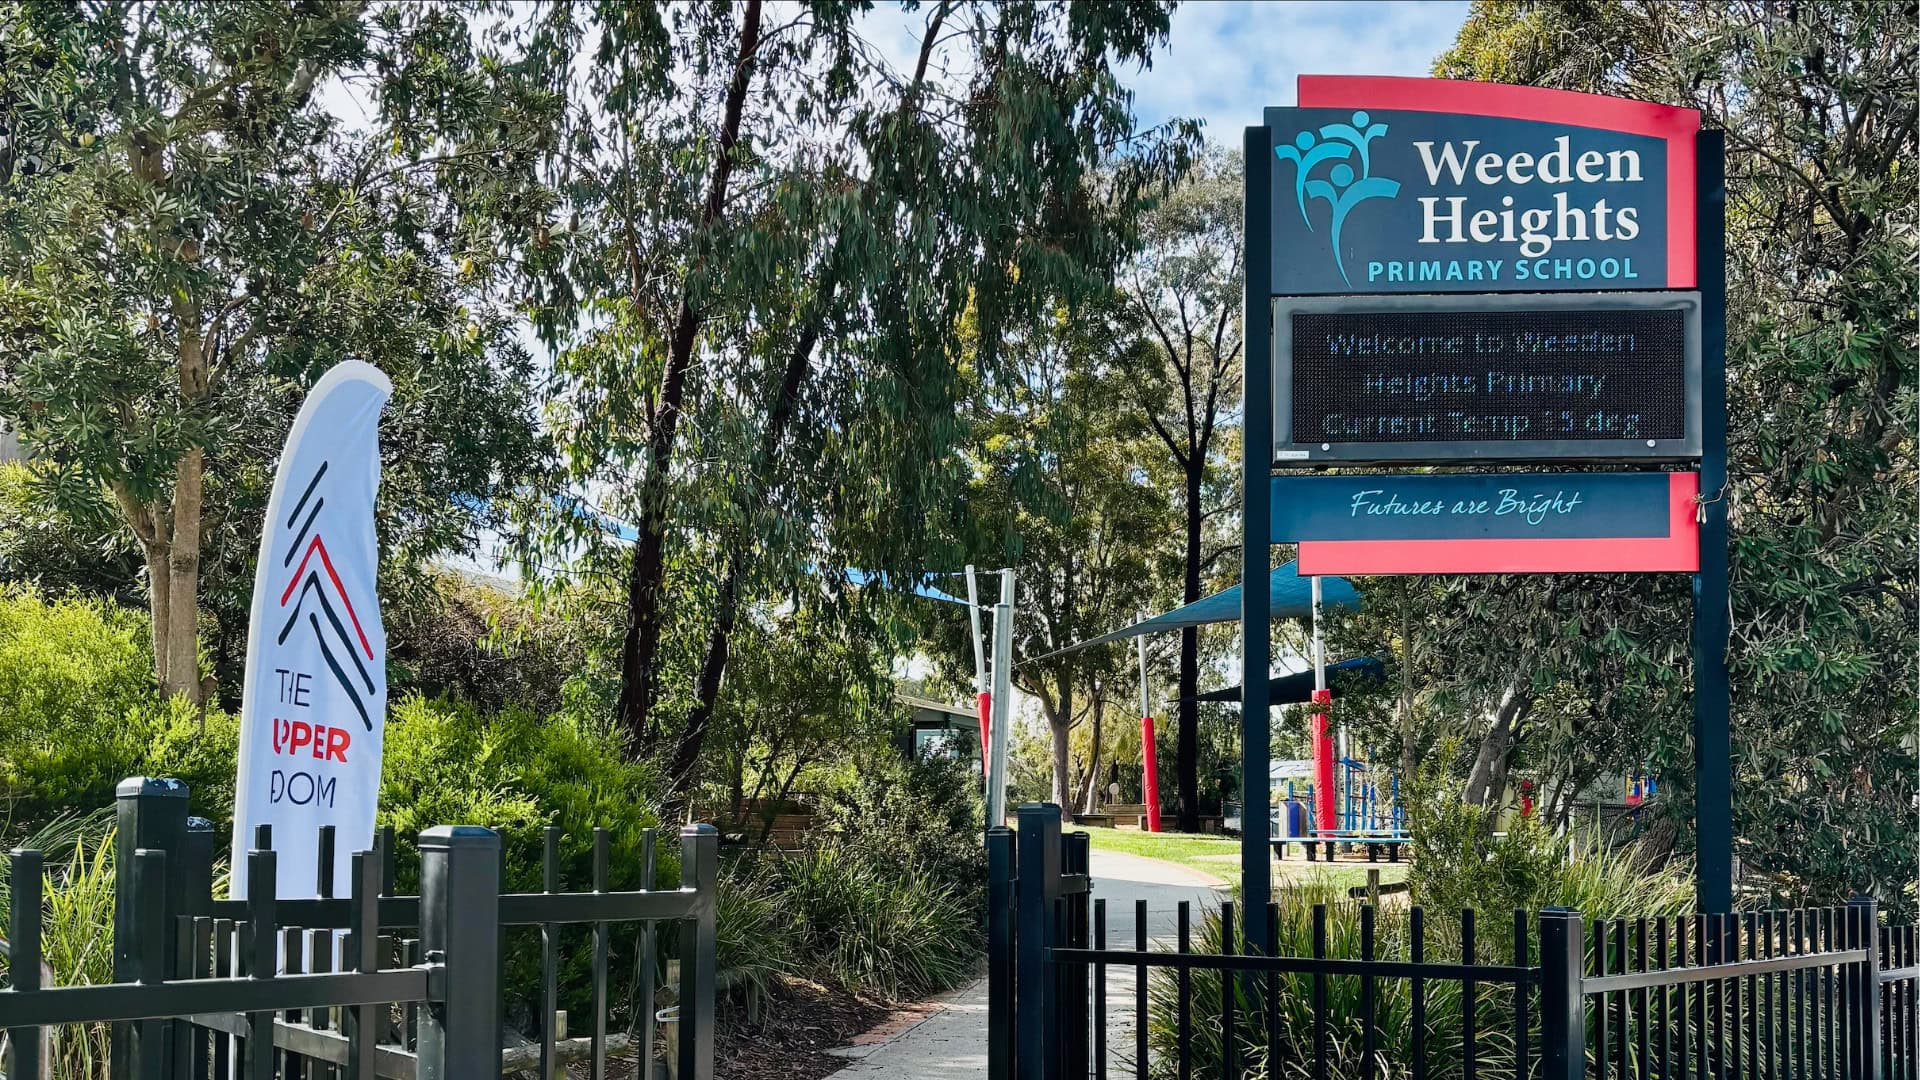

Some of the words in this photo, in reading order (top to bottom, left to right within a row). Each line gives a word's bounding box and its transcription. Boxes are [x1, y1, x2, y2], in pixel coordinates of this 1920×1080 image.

[1413, 135, 1643, 186] Weeden
[1417, 192, 1640, 258] Heights
[1368, 260, 1504, 282] PRIMARY
[1515, 257, 1638, 280] SCHOOL
[1326, 332, 1464, 355] Welcome
[1475, 332, 1503, 354] to
[1515, 330, 1636, 353] Weeden
[1362, 372, 1476, 402] Heights
[1487, 371, 1607, 400] Primary
[1322, 412, 1436, 435] Current
[1446, 411, 1529, 439] Temp
[1585, 409, 1640, 439] deg
[1350, 490, 1444, 517] Futures
[1452, 500, 1490, 515] are
[1494, 489, 1582, 525] Bright
